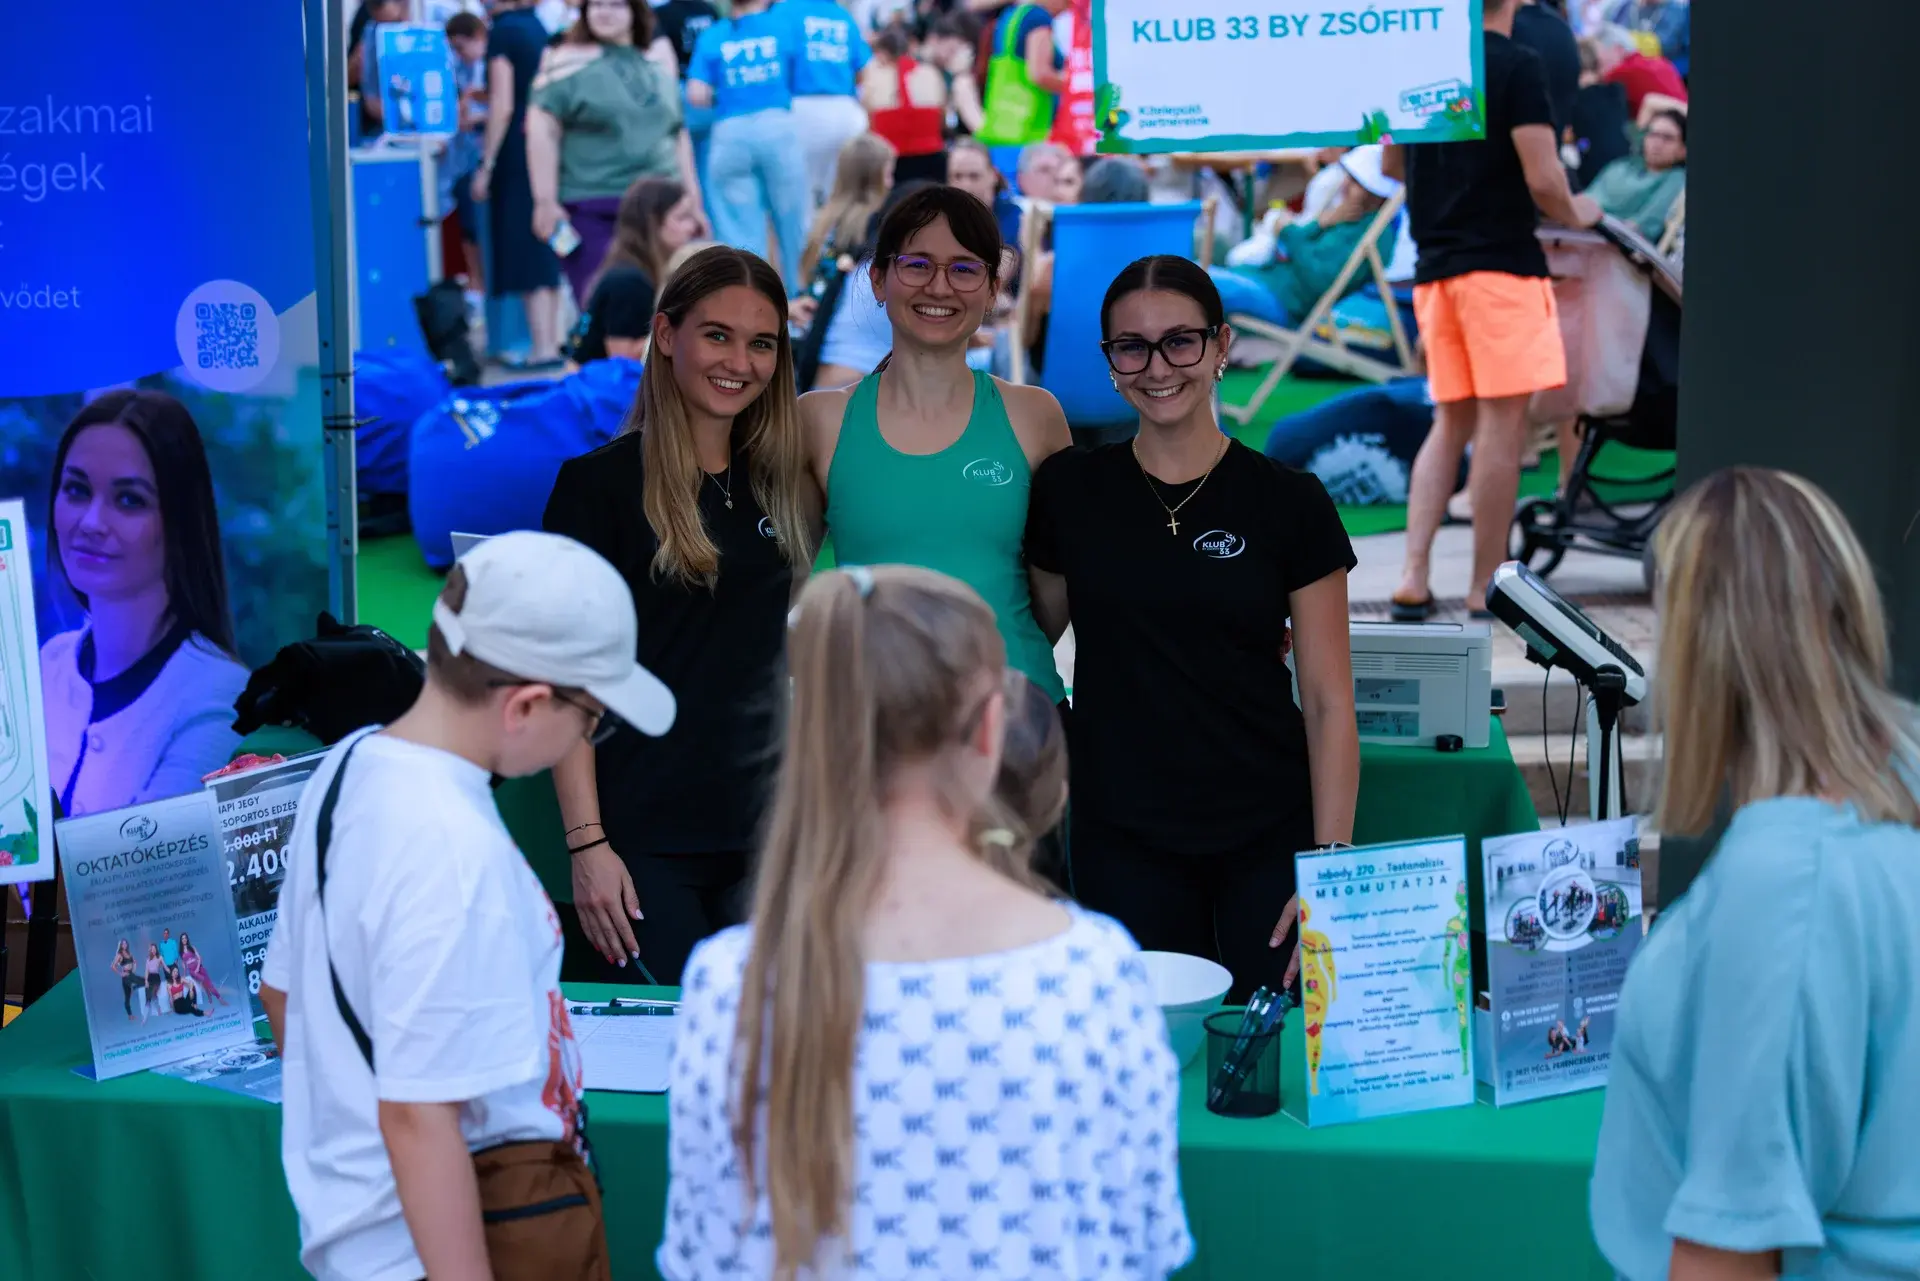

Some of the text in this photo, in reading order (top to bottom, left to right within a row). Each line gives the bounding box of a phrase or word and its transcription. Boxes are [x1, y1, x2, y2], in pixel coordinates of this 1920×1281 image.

[1132, 4, 1444, 43] KLUB 33 BY ZSÓFITT
[238, 796, 261, 809] JEGY
[221, 800, 298, 828] SOPORTOS EDZÉS
[265, 826, 278, 842] FT
[76, 833, 209, 877] OKTATÓKÉPZÉS
[1356, 864, 1375, 877] 270
